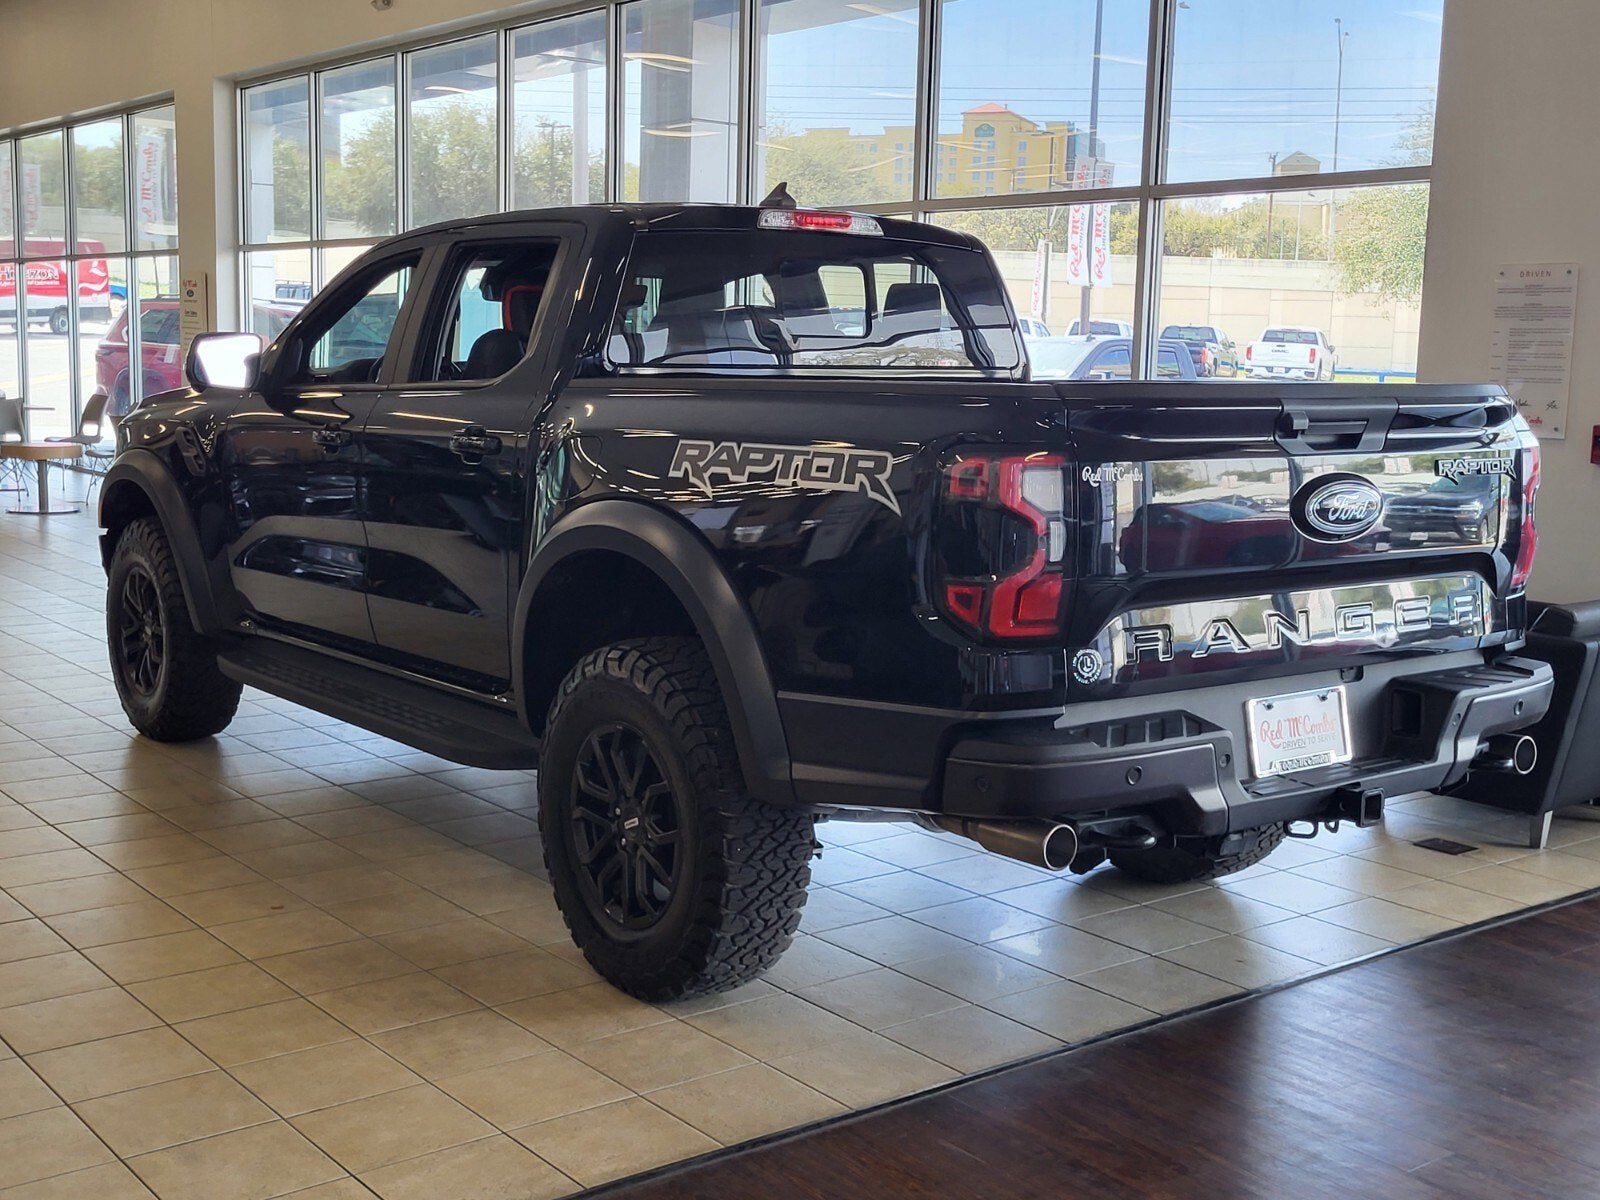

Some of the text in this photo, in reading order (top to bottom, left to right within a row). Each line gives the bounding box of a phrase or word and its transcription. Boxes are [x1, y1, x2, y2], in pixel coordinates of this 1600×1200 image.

[1070, 243, 1083, 278] Red
[1094, 246, 1106, 279] Red
[1520, 270, 1552, 278] DRIVEN
[668, 439, 901, 517] RAPTOR
[1082, 466, 1144, 487] Red McCombs
[1436, 458, 1516, 485] RAPTOR
[1328, 494, 1369, 521] Ford
[1124, 590, 1484, 665] RANGER
[1260, 712, 1337, 749] Red McCombs
[1282, 738, 1307, 750] DRIVEN
[1308, 736, 1317, 746] TO
